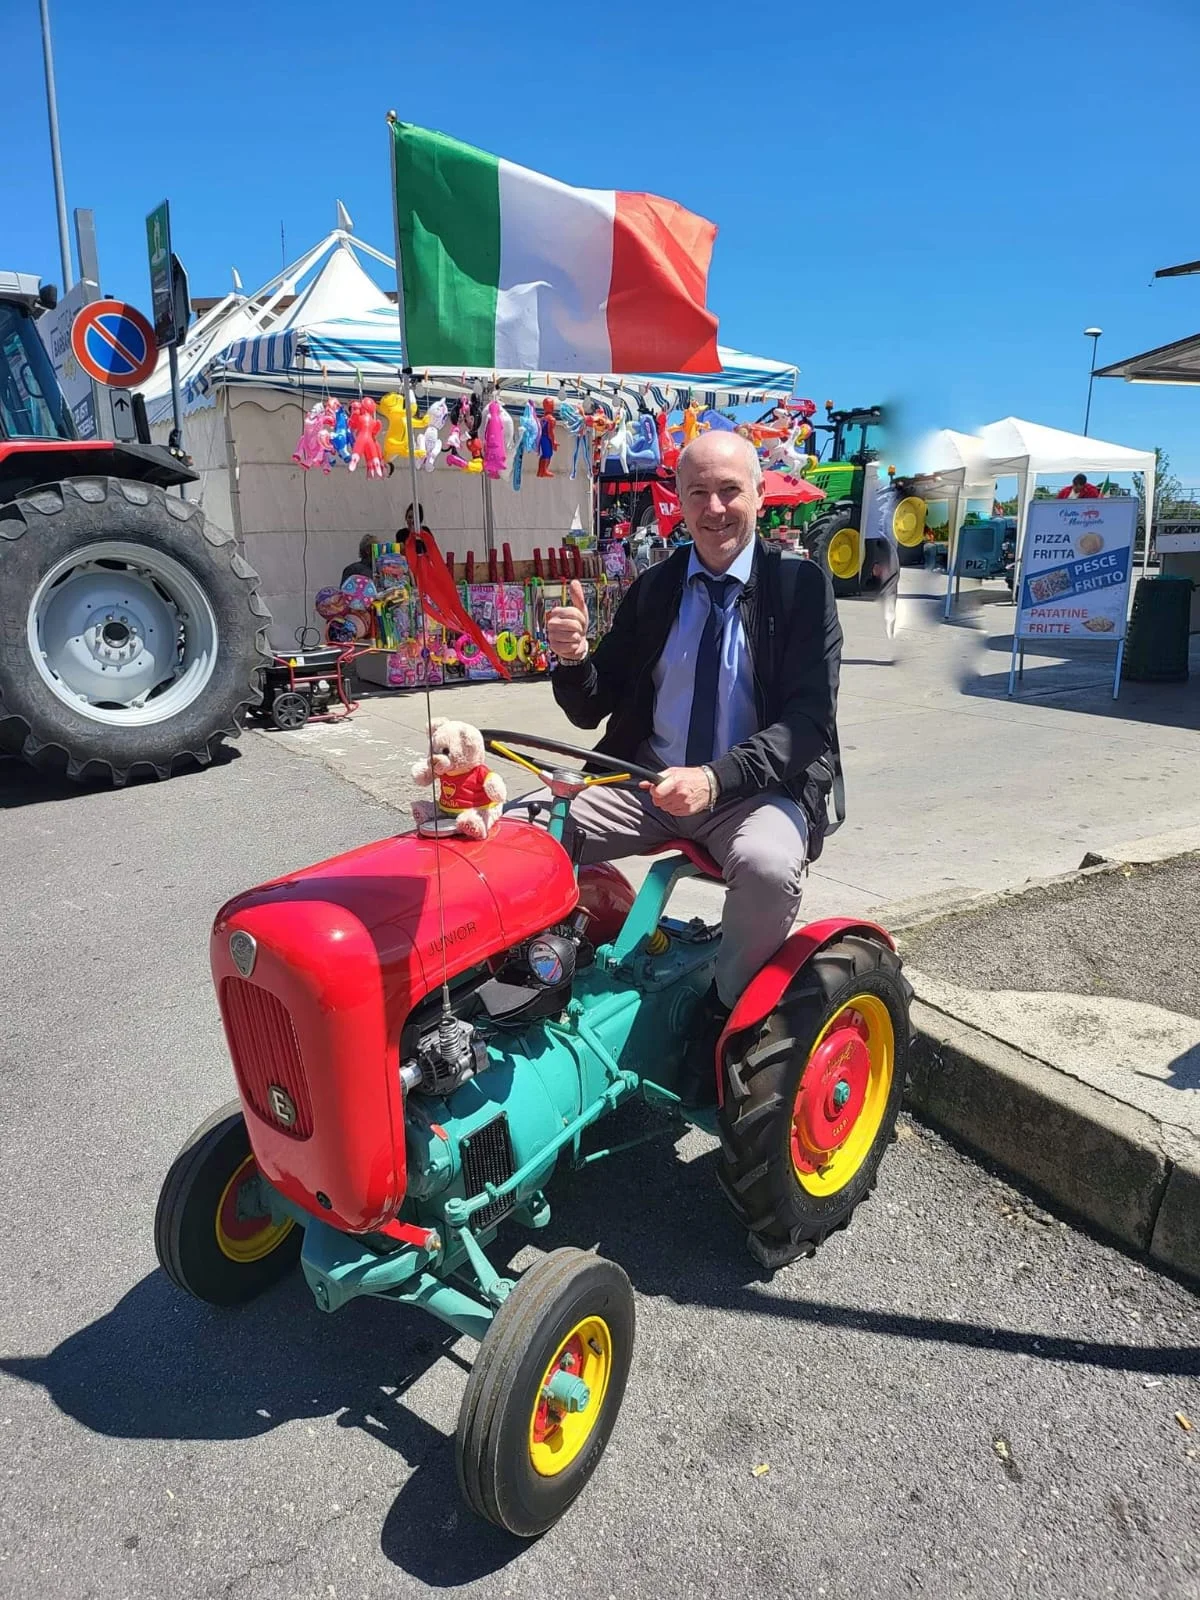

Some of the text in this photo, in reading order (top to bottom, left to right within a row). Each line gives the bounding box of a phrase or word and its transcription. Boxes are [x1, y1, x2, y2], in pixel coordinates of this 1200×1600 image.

[1034, 534, 1071, 544] PIZZA
[1033, 549, 1075, 559] FRITTA
[1074, 555, 1118, 576] PESCE
[1074, 570, 1124, 593] FRITTO
[1030, 608, 1089, 618] PATATINE
[1028, 623, 1071, 634] FRITTE
[429, 921, 477, 957] JUNIOR
[271, 1090, 290, 1121] E
